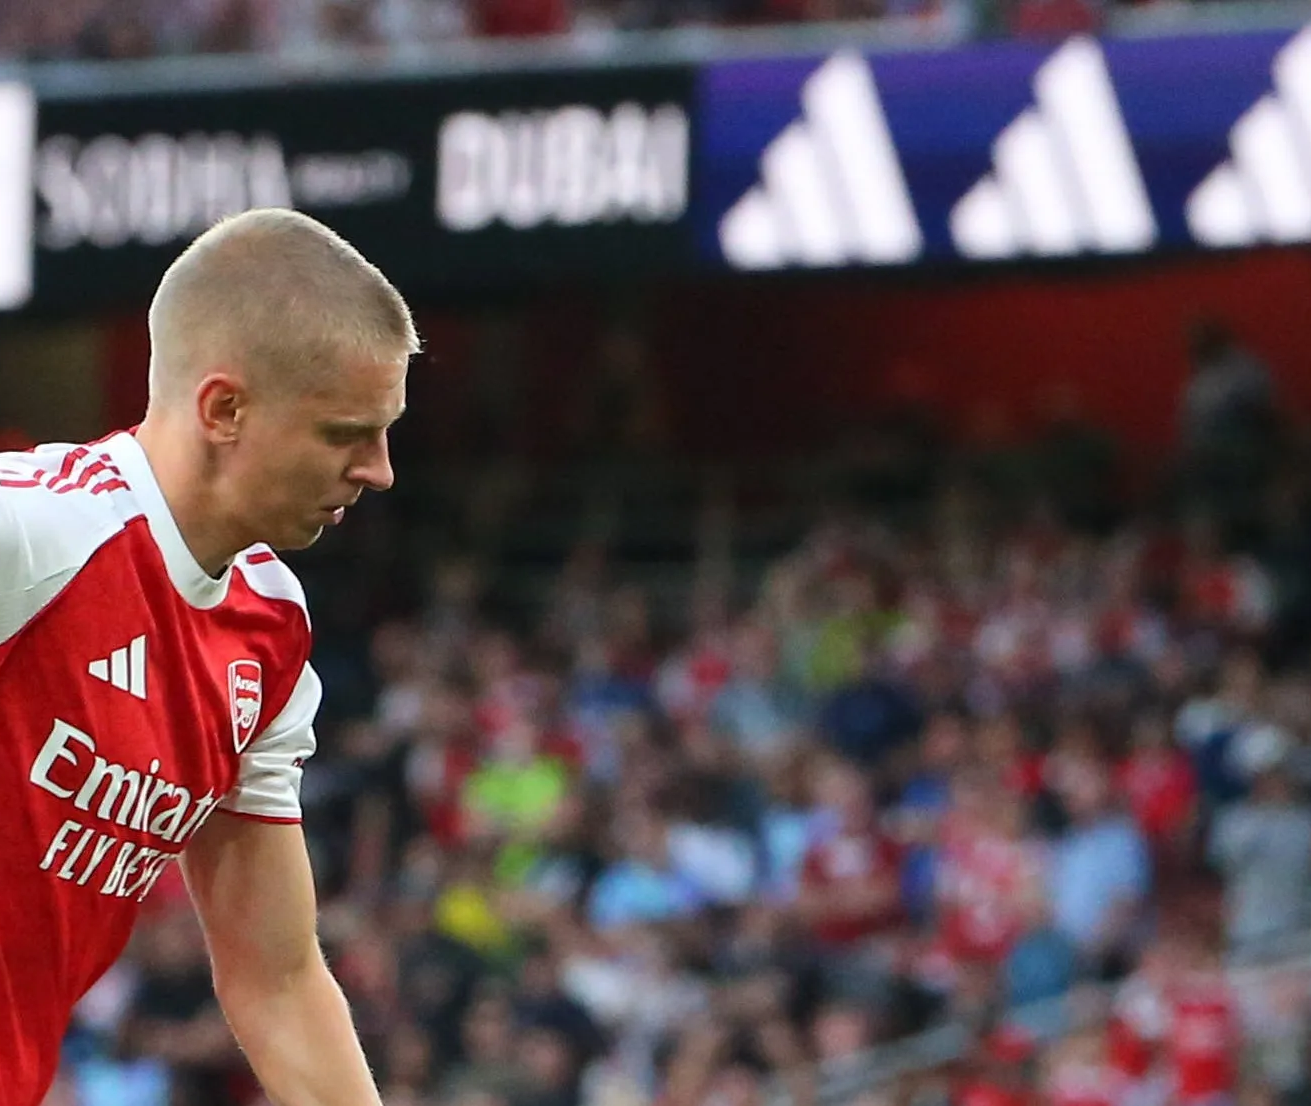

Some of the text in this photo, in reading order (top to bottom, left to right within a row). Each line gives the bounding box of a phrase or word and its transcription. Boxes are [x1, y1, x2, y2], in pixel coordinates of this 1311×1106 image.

[437, 102, 687, 230] DUBAI
[29, 718, 225, 843] Emirat
[39, 819, 117, 886] FLY
